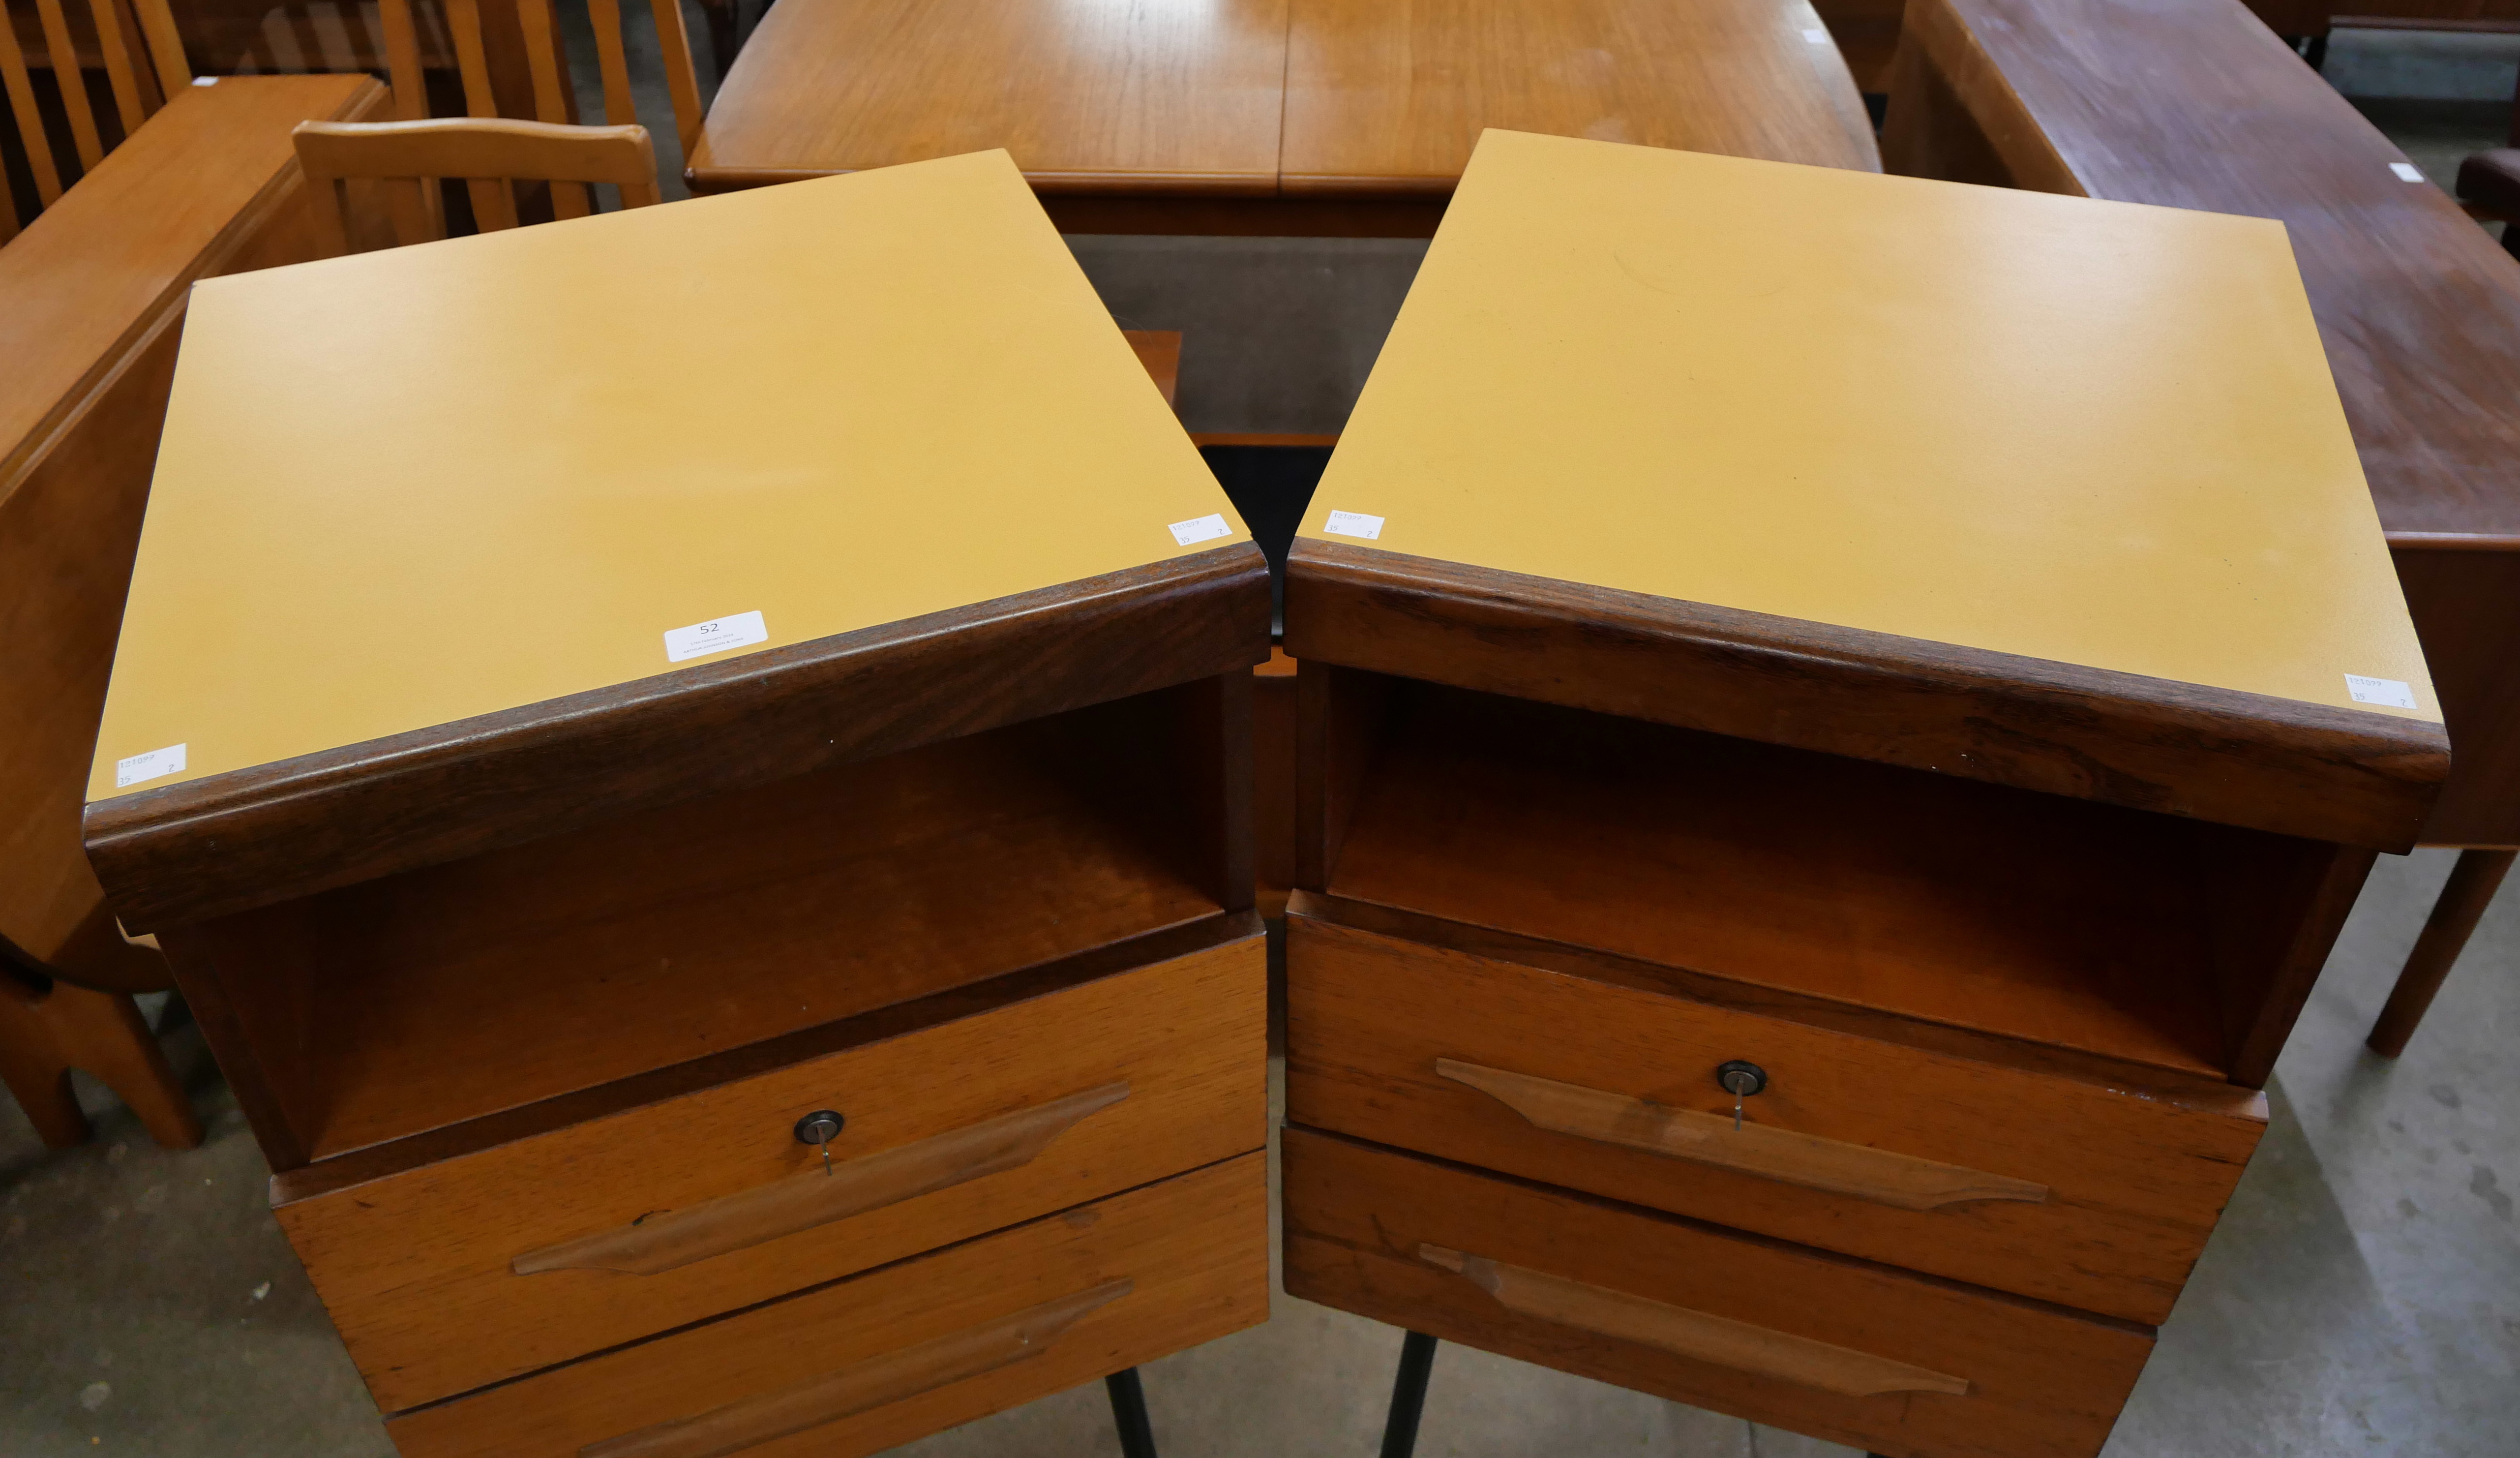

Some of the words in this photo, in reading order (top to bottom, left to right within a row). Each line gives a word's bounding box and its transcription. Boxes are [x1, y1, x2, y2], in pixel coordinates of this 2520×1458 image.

[1334, 513, 1361, 521] 121099
[700, 623, 720, 634] 52
[2349, 677, 2381, 687] 121099
[120, 754, 154, 768] 121099
[169, 764, 175, 772] 2
[118, 775, 130, 786] 35
